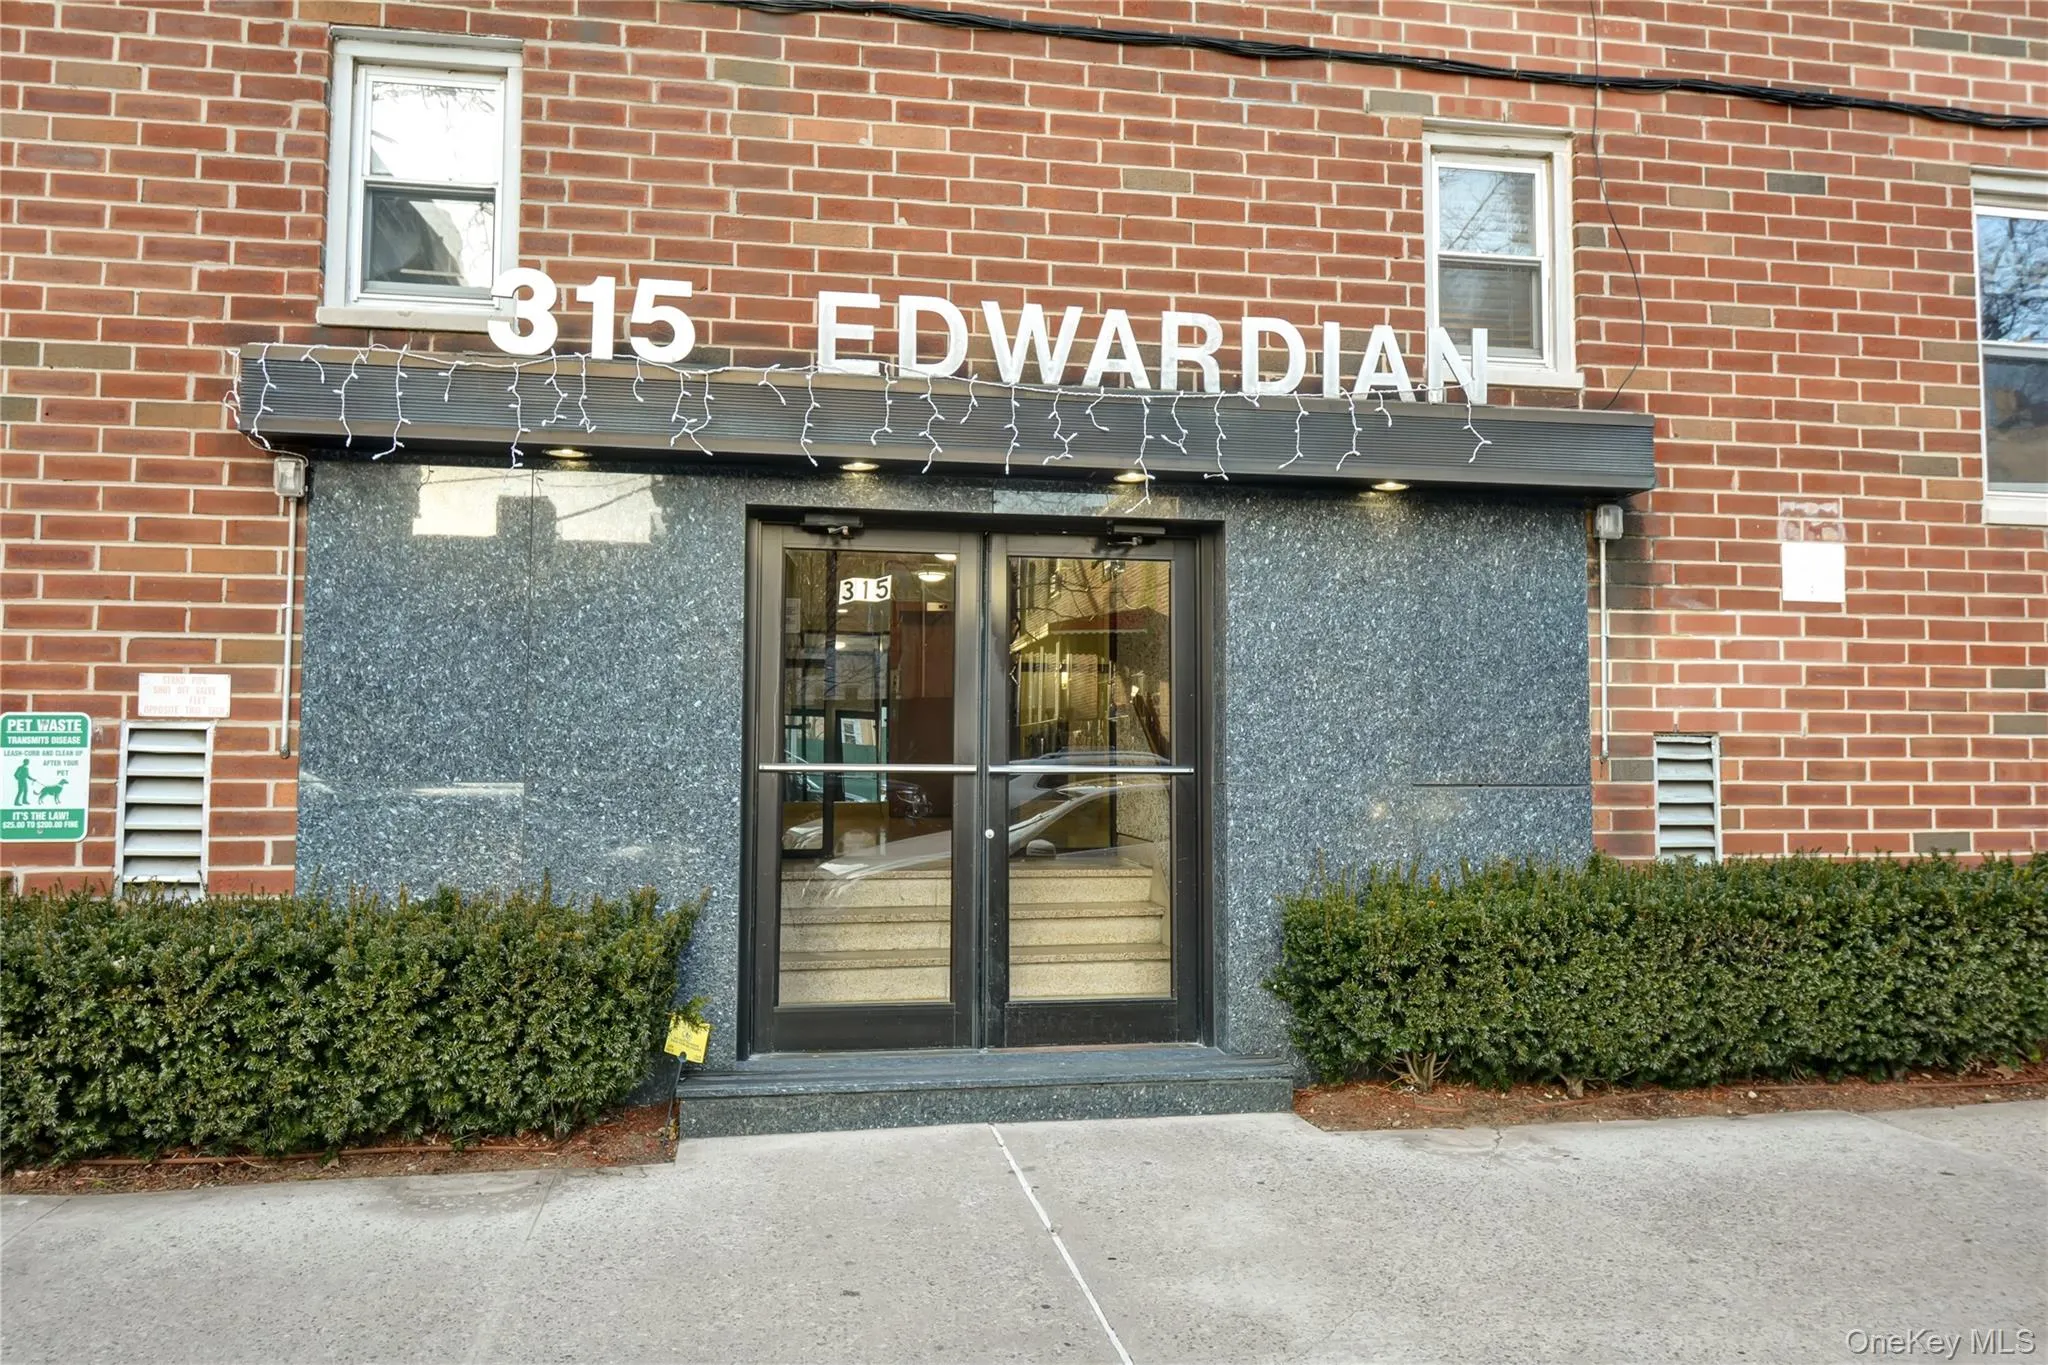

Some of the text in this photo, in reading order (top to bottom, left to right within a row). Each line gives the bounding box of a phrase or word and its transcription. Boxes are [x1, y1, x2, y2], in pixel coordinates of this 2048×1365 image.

[487, 267, 1489, 405] 315 EDWARDIAN
[841, 578, 889, 601] 315
[7, 719, 82, 732] PET WASTE
[7, 735, 81, 745] TRANSMITS DISEASE
[42, 759, 79, 767] AFTER YOUR
[56, 769, 69, 777] PET
[12, 811, 70, 821] IT'S THE LAW!
[26, 821, 36, 829] TO
[63, 820, 79, 829] FINE
